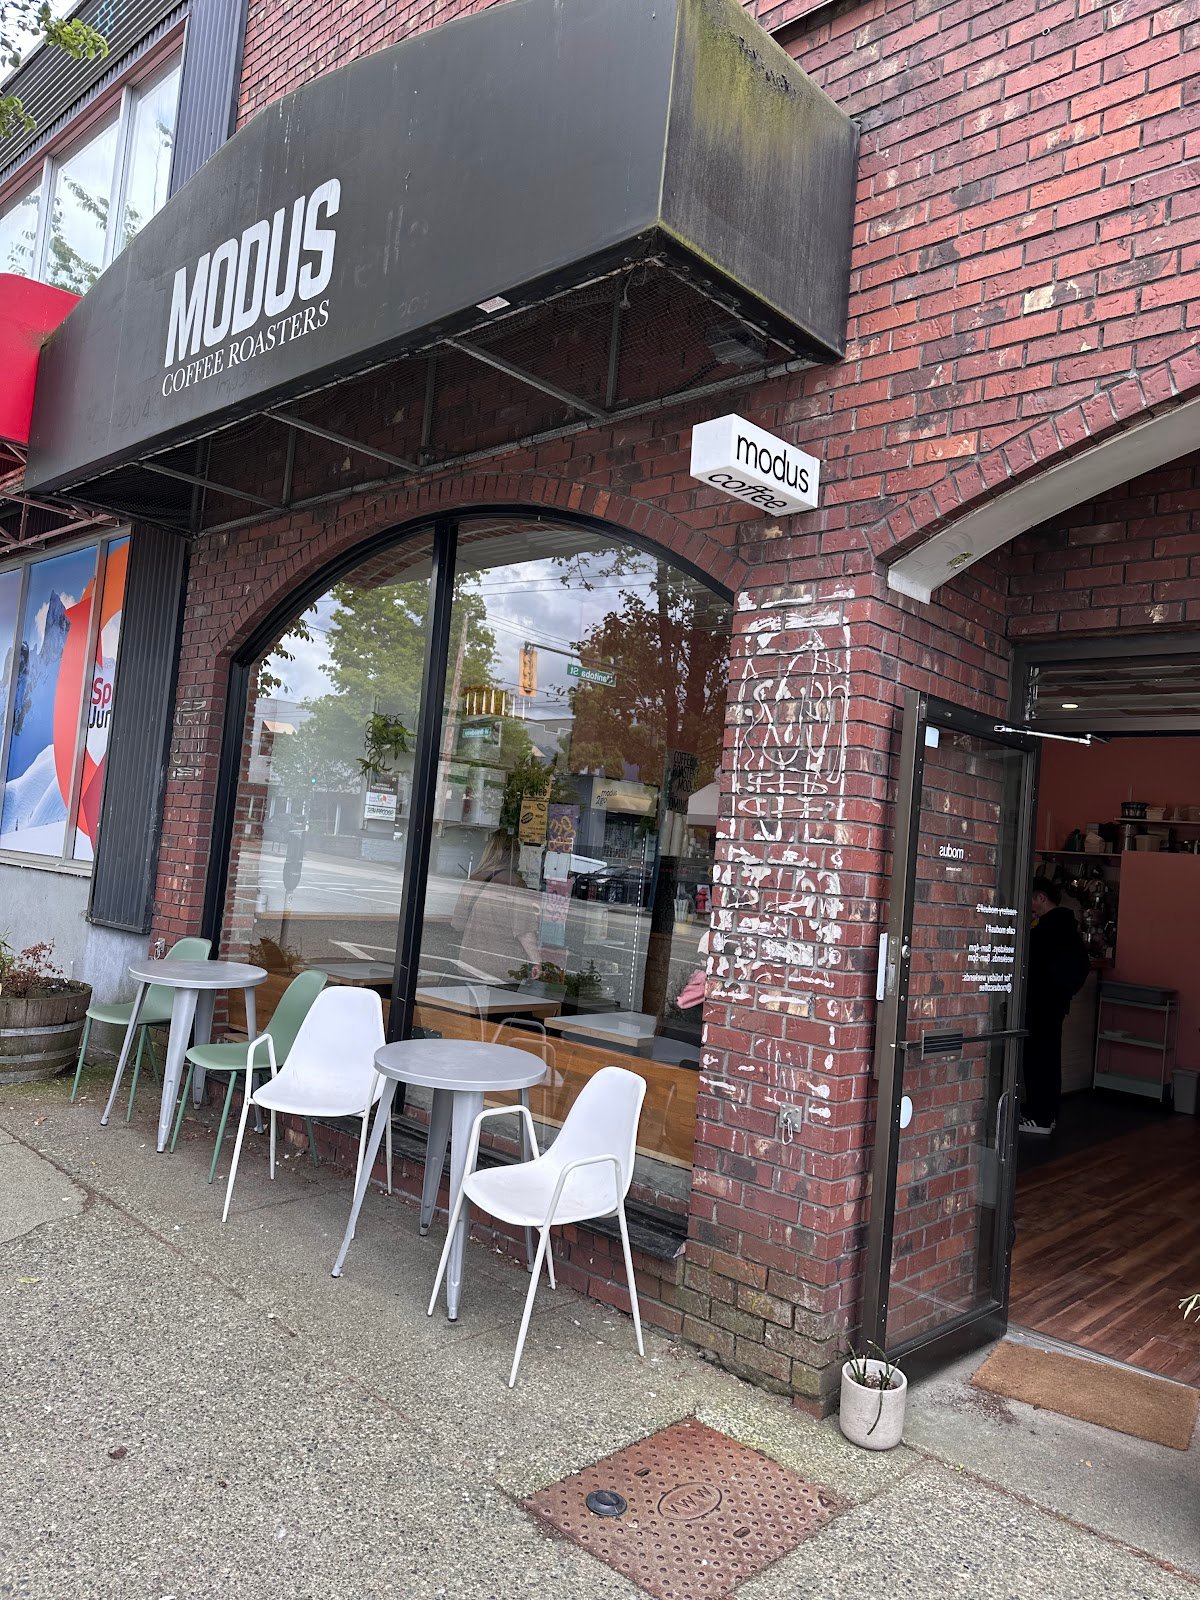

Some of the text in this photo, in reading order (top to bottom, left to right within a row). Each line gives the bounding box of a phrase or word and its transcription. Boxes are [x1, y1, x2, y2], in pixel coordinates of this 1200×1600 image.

[164, 178, 341, 368] MODUS
[161, 299, 330, 397] COFFEE ROASTERS
[708, 474, 788, 509] coffee
[736, 434, 809, 494] modus
[91, 677, 112, 709] Sp
